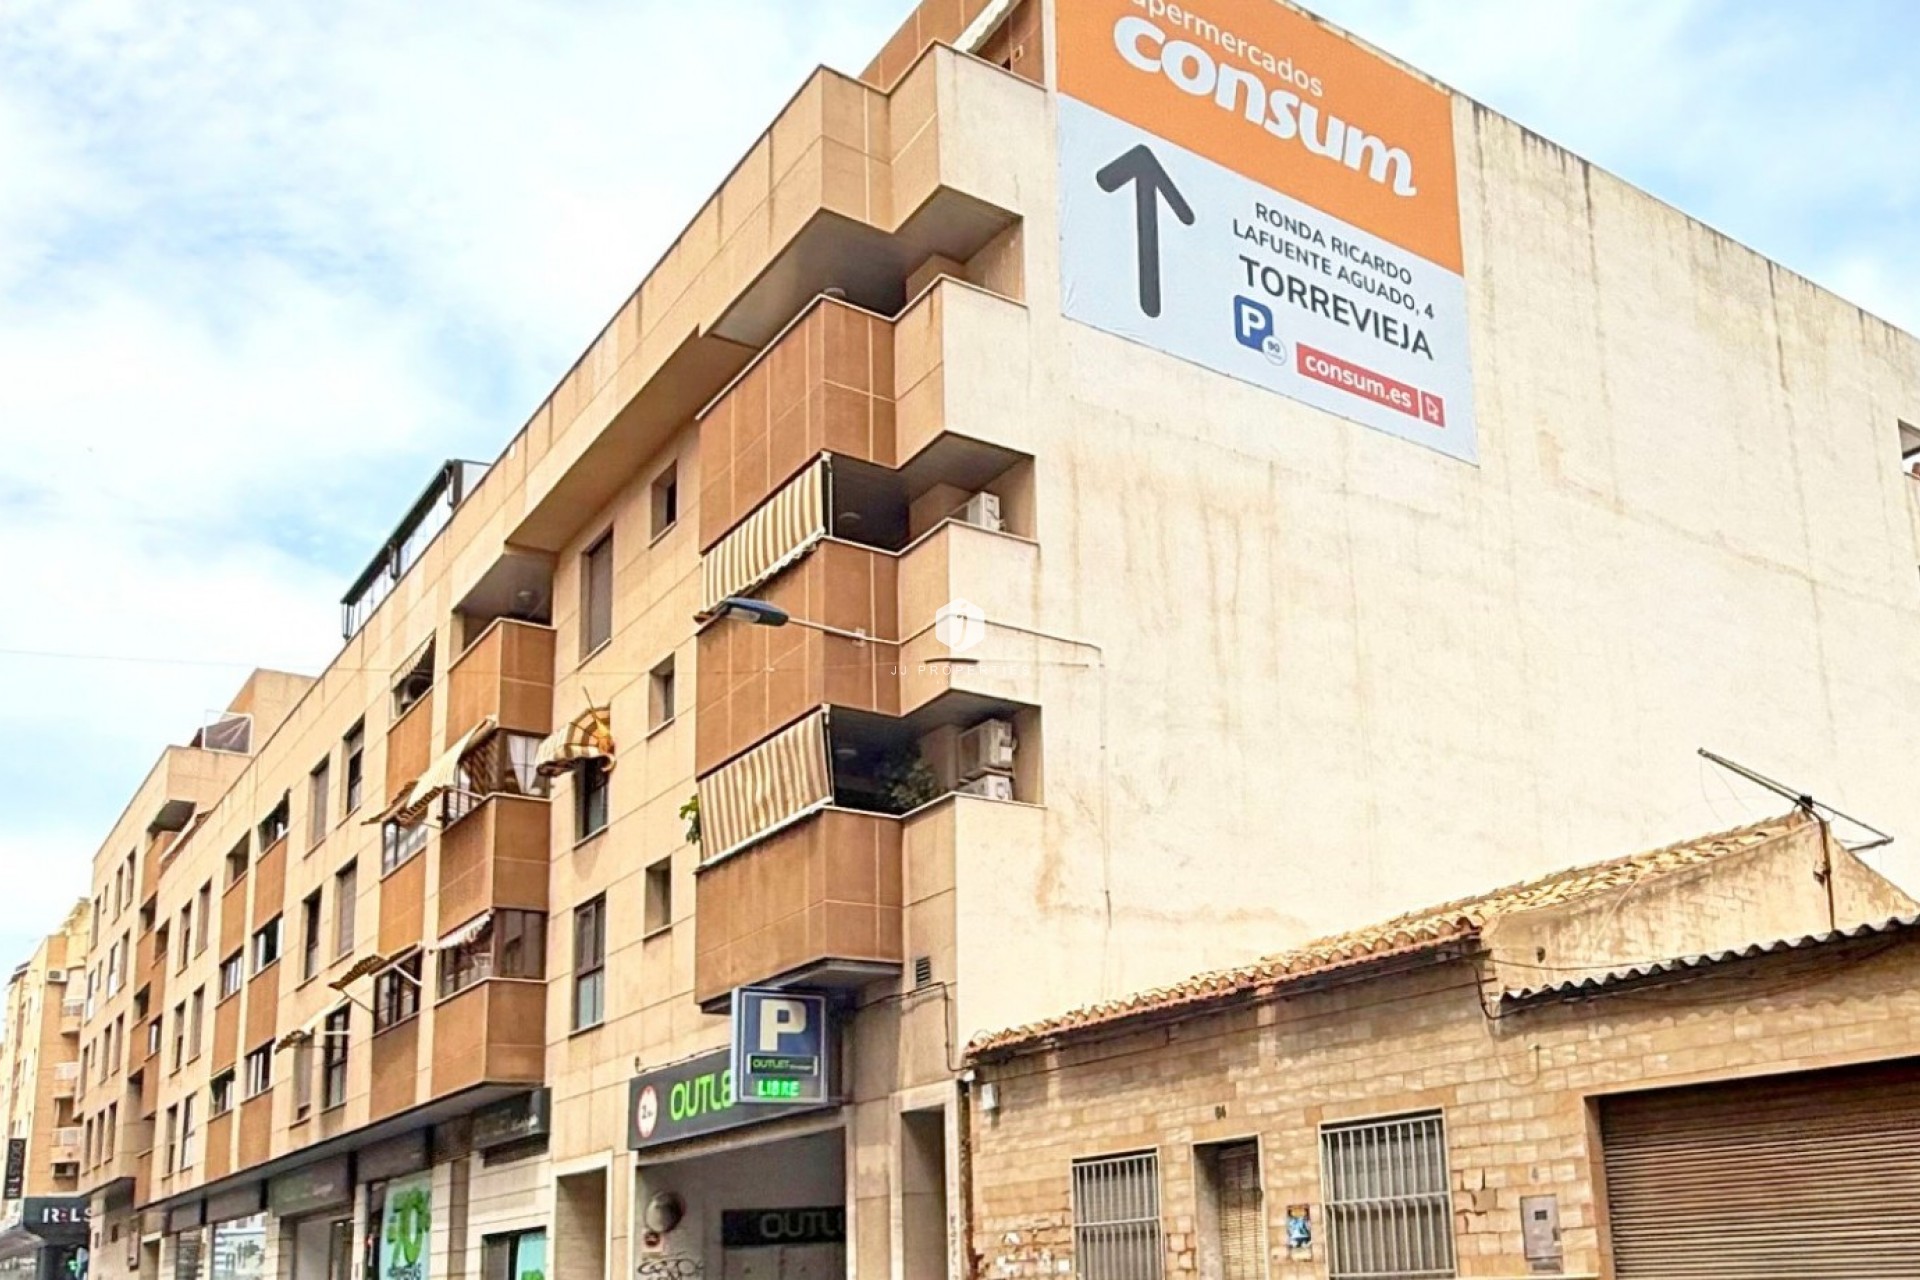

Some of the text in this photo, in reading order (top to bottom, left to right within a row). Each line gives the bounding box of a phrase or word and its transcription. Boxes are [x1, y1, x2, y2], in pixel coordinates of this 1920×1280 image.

[1113, 16, 1417, 196] consum
[1233, 219, 1434, 319] LAFUENTE AGUADO, 4
[1255, 202, 1412, 285] RONDA RICARDO
[1239, 254, 1434, 361] TORREVIEJA
[1241, 304, 1266, 337] P
[1305, 355, 1412, 409] consum.es
[760, 999, 806, 1051] P
[752, 1058, 791, 1069] OUTLET
[758, 1080, 800, 1096] LIBRE
